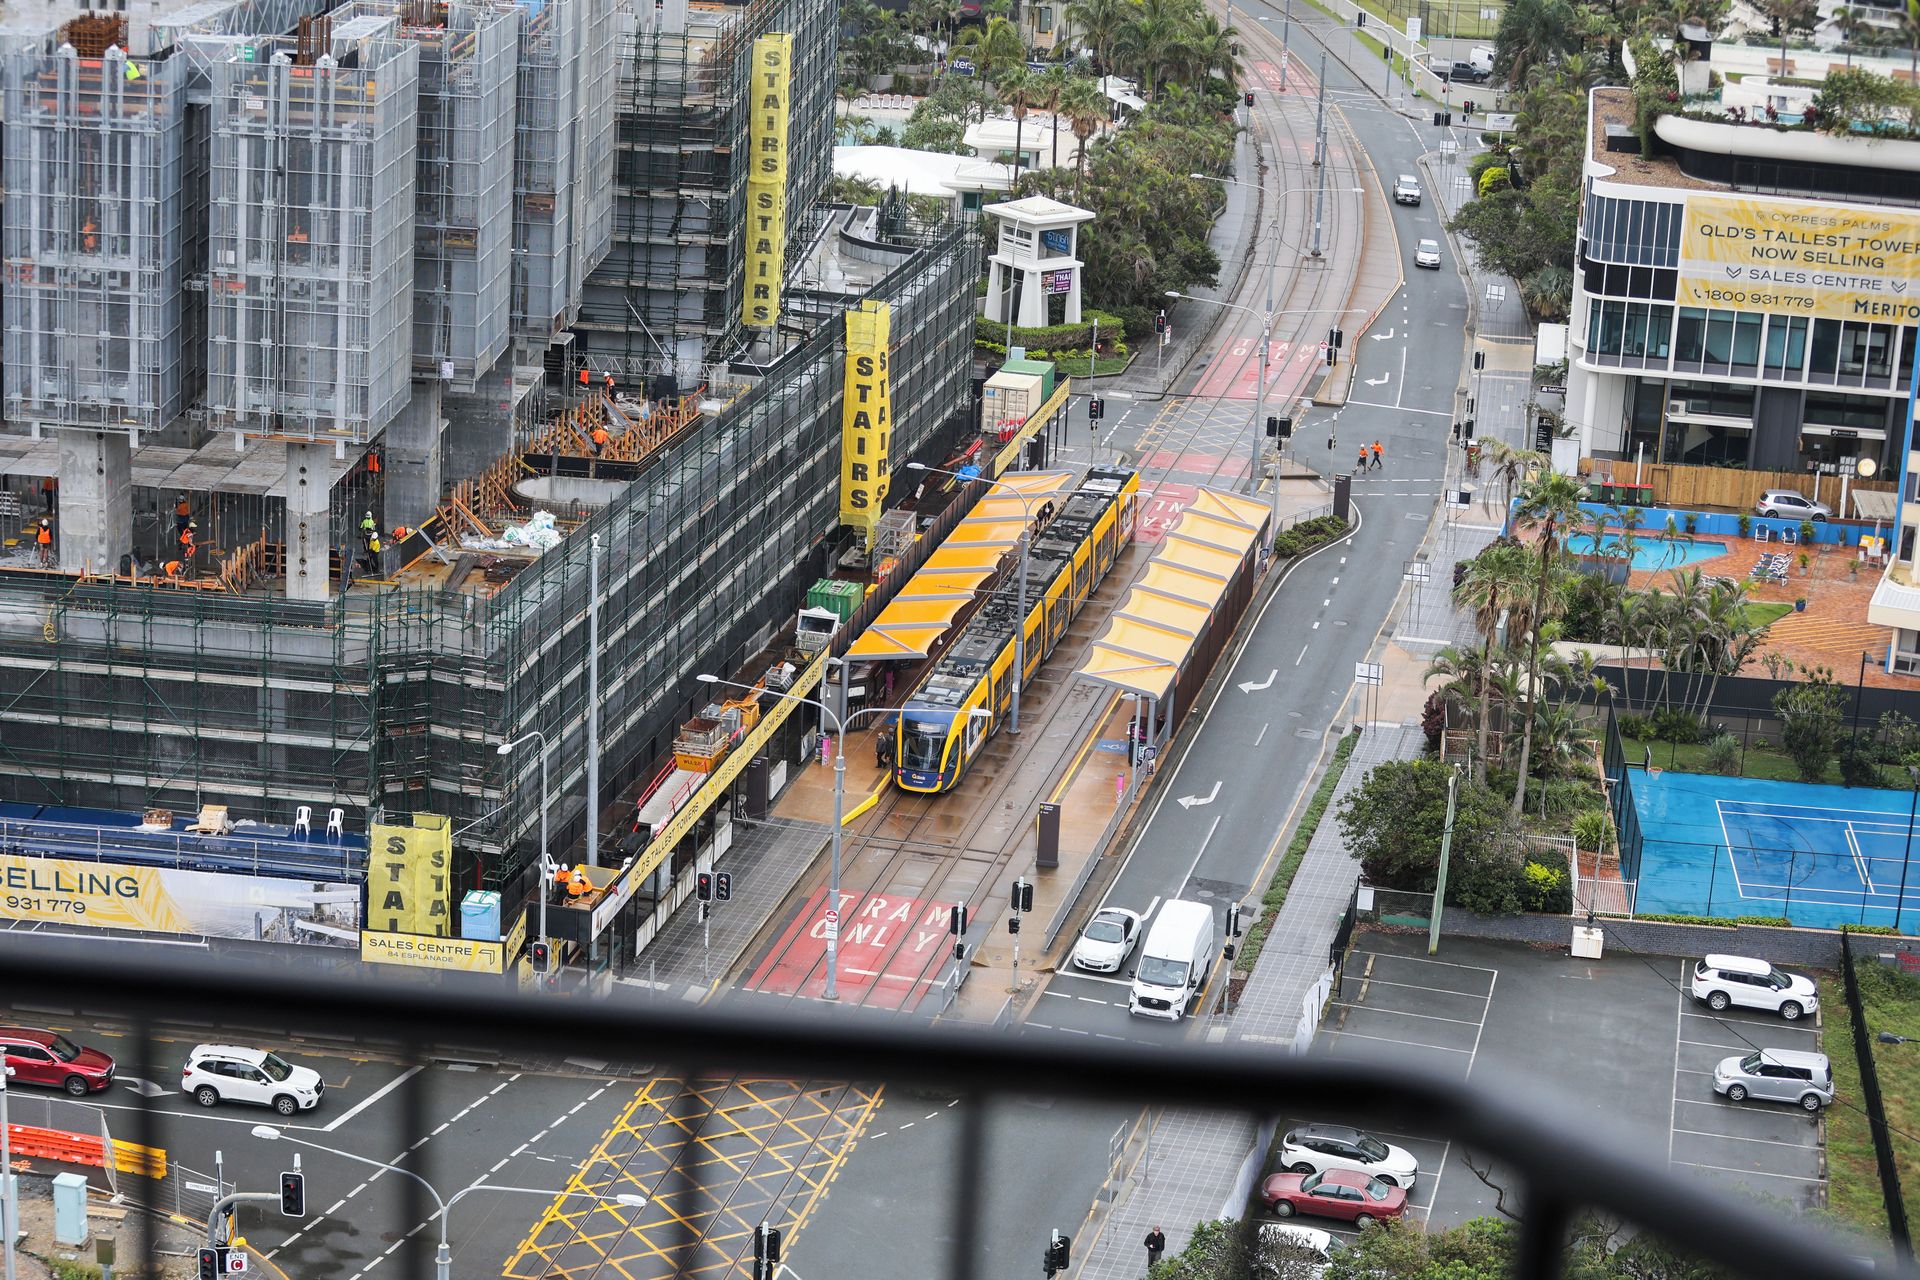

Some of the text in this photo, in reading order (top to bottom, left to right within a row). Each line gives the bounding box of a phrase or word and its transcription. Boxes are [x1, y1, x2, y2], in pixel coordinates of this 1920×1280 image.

[762, 51, 781, 173] STAIRS
[1771, 213, 1891, 232] CYPRESS PALMS
[1700, 224, 1756, 240] QLD'S
[1762, 229, 1851, 248] TALLEST
[753, 193, 773, 320] STAIRS
[1751, 246, 1885, 269] NOW SELLING
[1056, 273, 1071, 282] THAI
[1749, 269, 1882, 291] SALES CENTRE
[1704, 289, 1815, 309] 1800 931 779
[1232, 347, 1310, 362] OLY
[1240, 338, 1316, 353] TAM
[851, 356, 874, 509] STAIRS
[875, 351, 888, 504] STAIRS
[651, 827, 676, 859] TALLEST
[0, 866, 139, 899] ELLING
[7, 895, 86, 914] 931 779
[838, 894, 952, 928] TRAM
[369, 938, 473, 956] SALES CENTRE
[387, 951, 454, 963] 84 ESPLANADE
